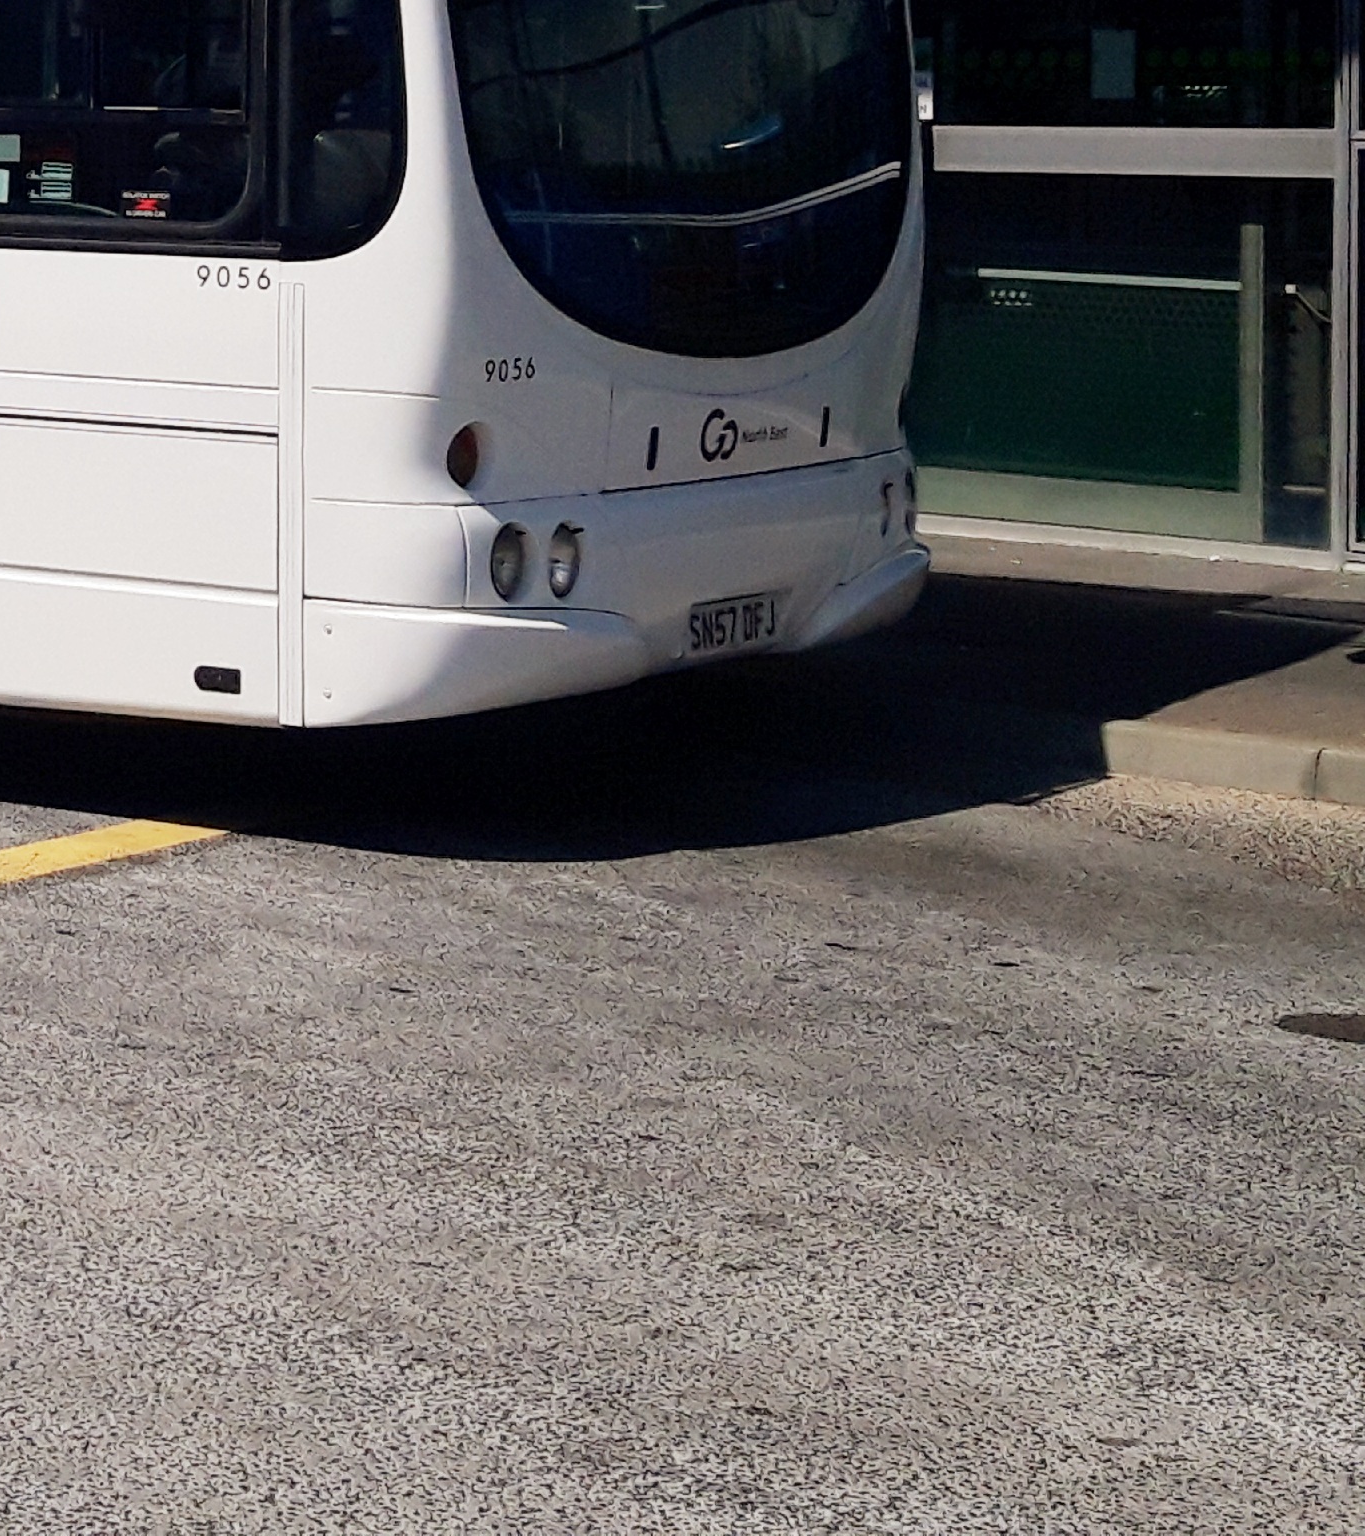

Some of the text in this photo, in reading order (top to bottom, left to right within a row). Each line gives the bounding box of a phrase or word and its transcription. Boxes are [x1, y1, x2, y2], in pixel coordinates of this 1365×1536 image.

[197, 265, 271, 290] 9056
[485, 356, 536, 383] 9056
[690, 606, 737, 651] SN57
